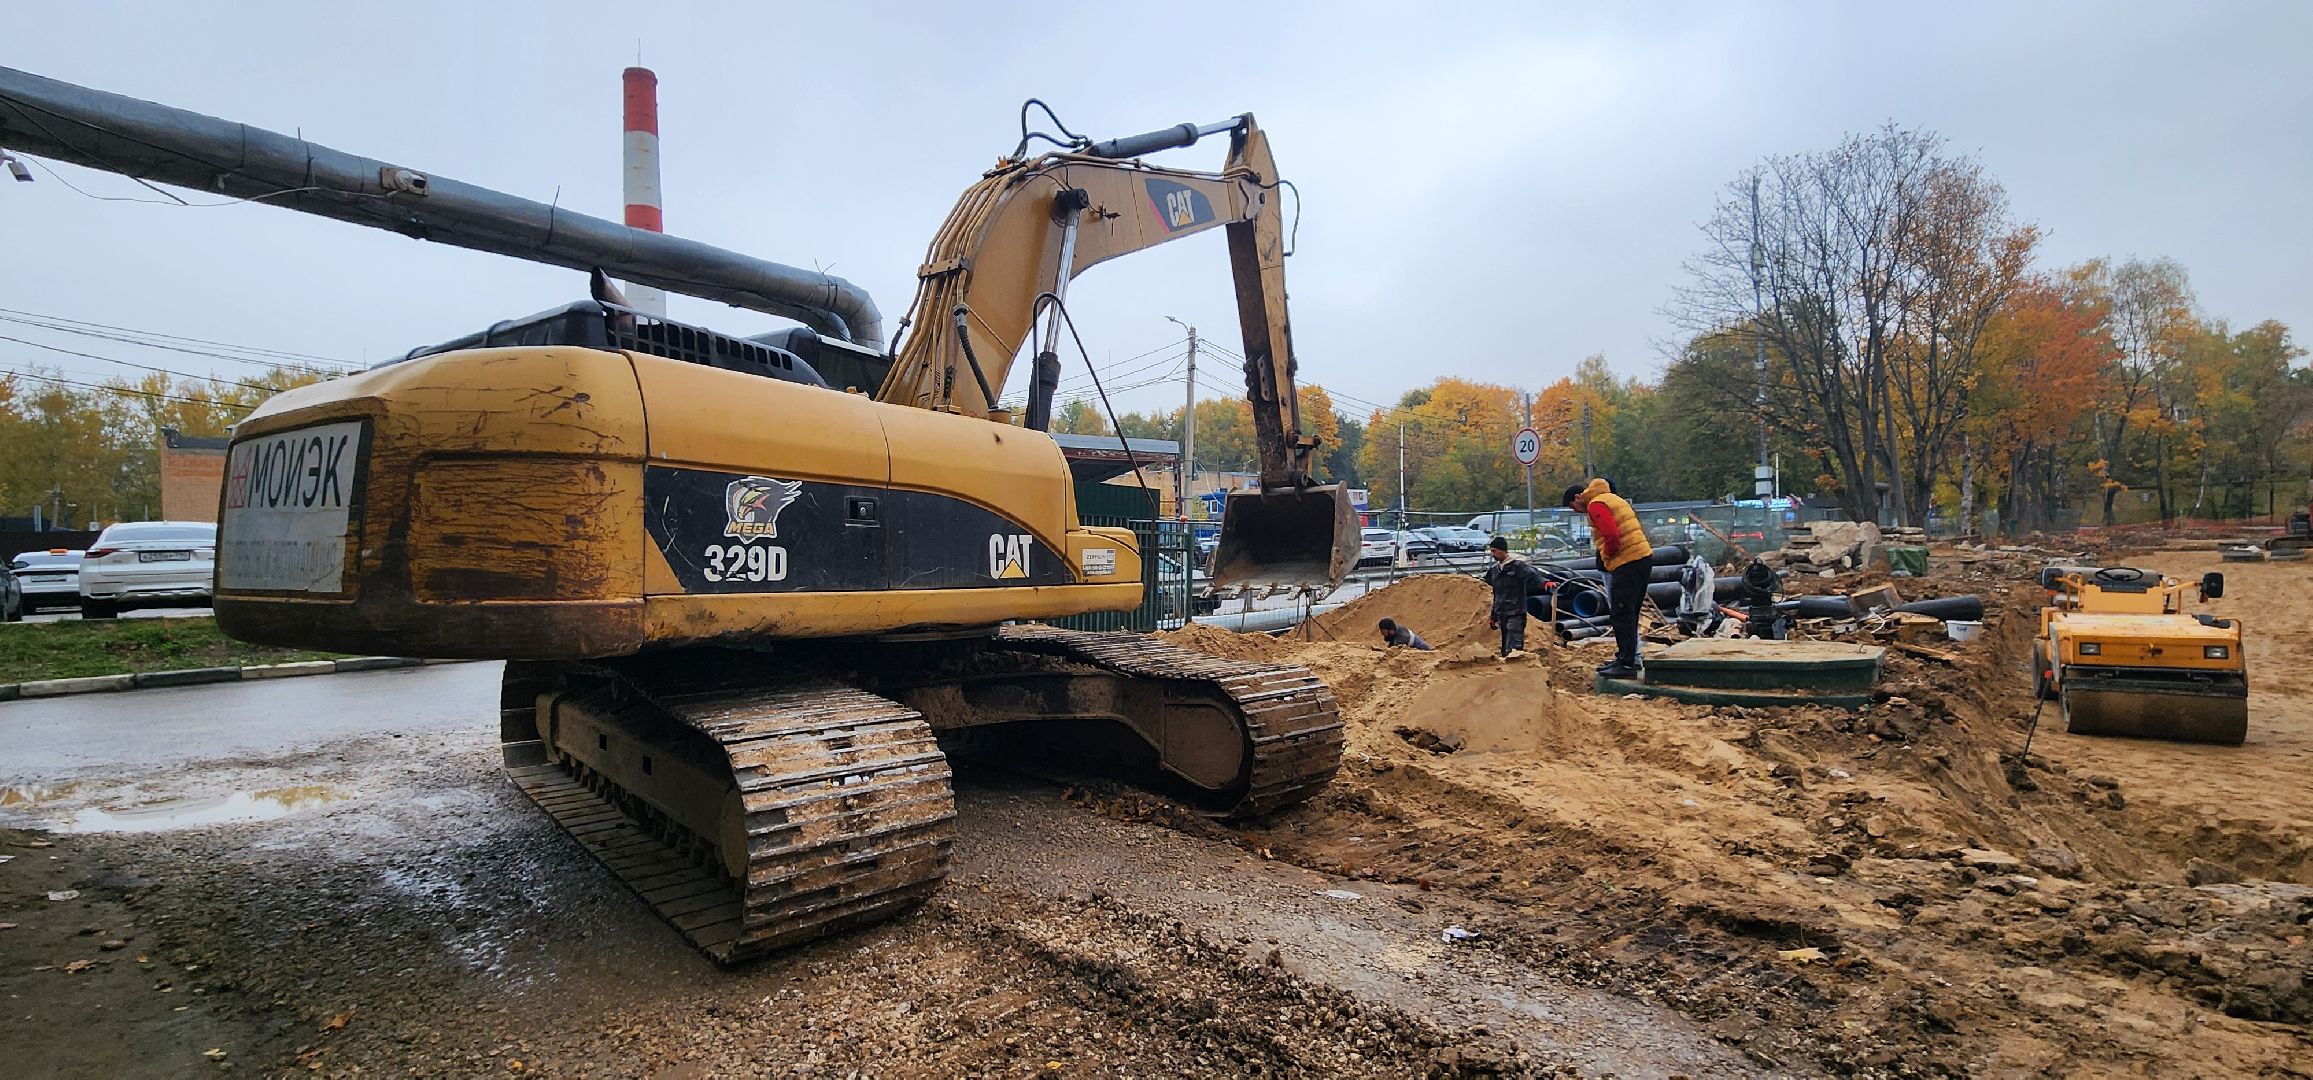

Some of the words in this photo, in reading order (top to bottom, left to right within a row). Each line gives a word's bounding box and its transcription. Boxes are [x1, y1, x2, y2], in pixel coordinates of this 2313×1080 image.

[1166, 189, 1195, 228] CAT
[1520, 439, 1535, 453] 20
[248, 434, 349, 508] МОИЭК
[727, 521, 774, 535] MEGA
[703, 544, 788, 583] 329D
[989, 533, 1033, 580] CAT
